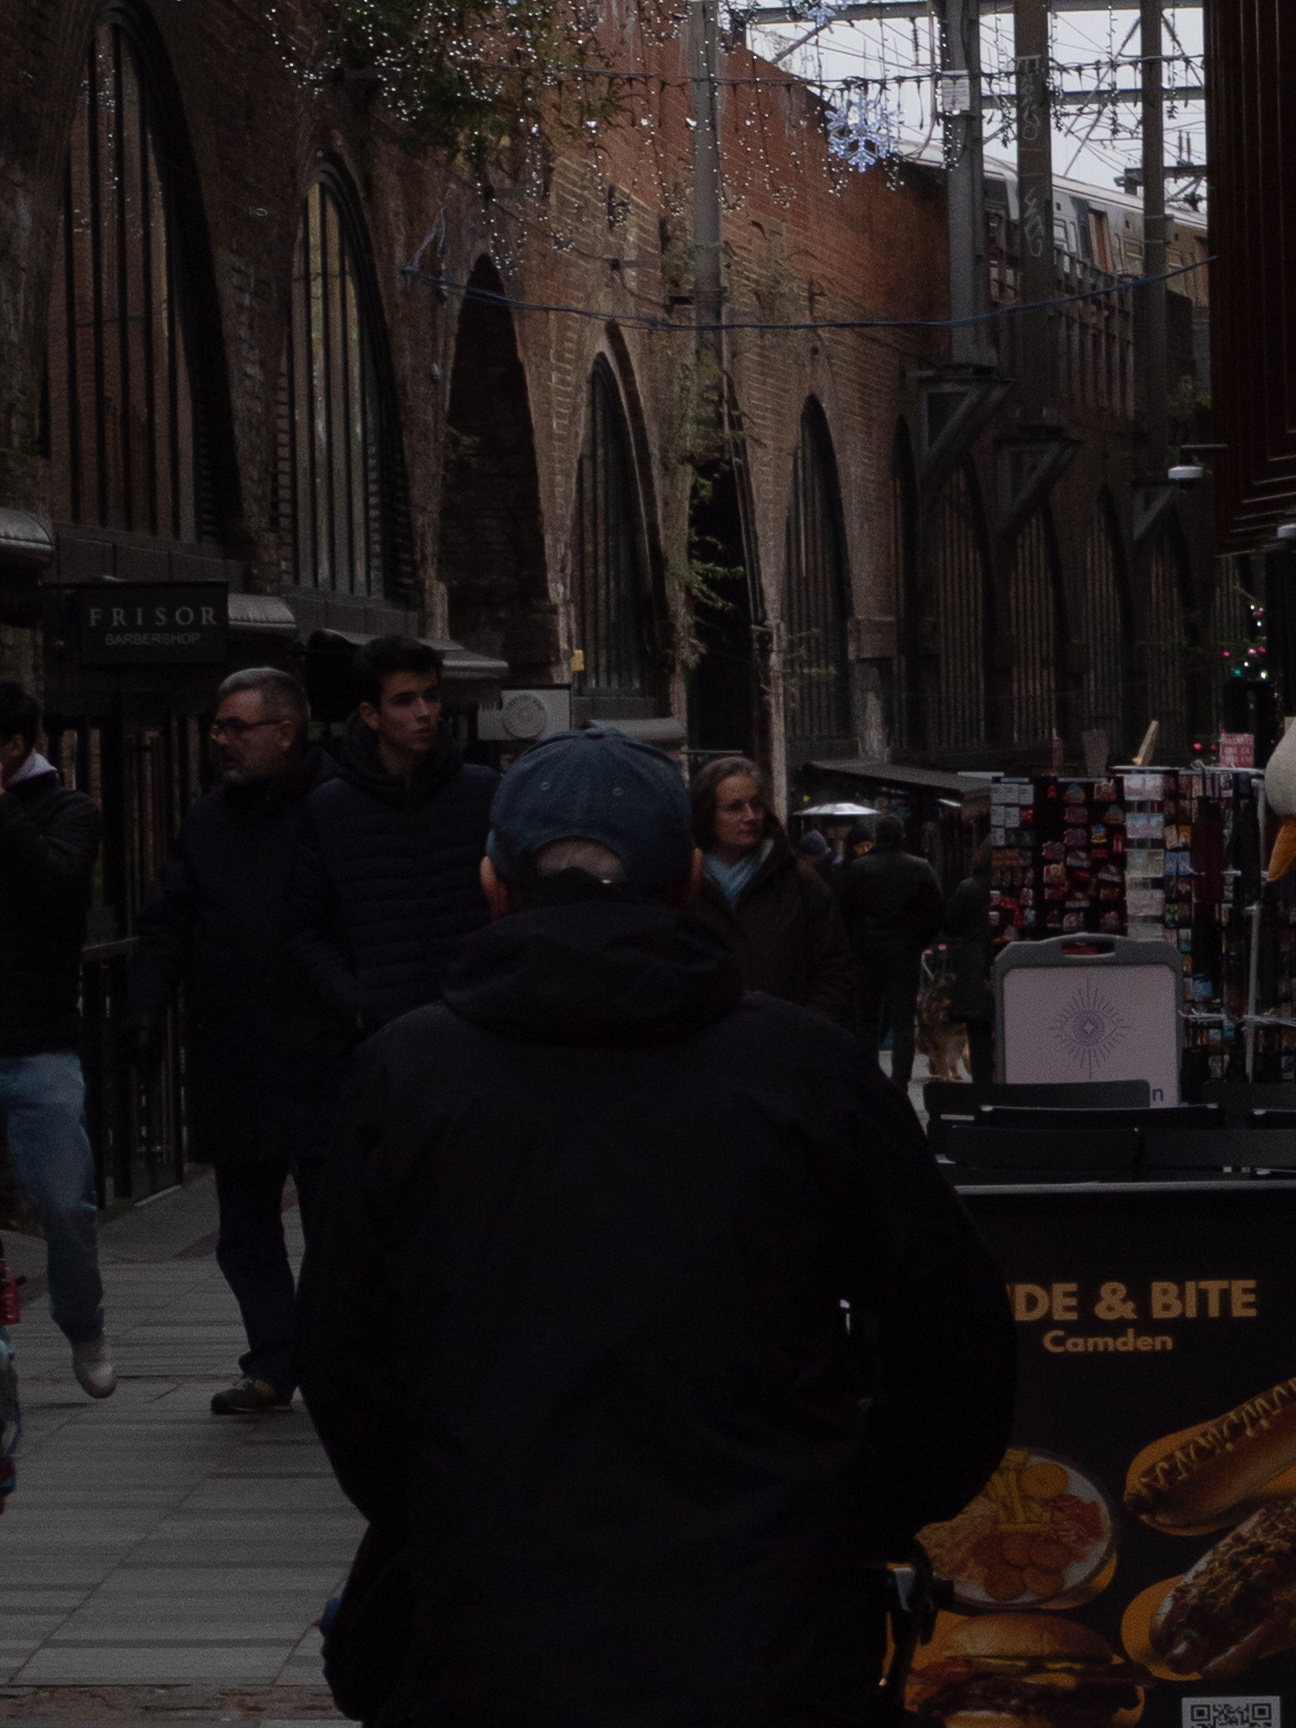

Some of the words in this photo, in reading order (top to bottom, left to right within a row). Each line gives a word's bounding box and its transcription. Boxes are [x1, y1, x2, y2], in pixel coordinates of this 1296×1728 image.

[89, 606, 217, 627] FRISOR
[105, 632, 201, 646] BARBERSHOP
[1006, 1282, 1079, 1321] DE
[1094, 1281, 1138, 1320] &
[1150, 1279, 1258, 1319] BITE
[1043, 1328, 1174, 1353] Camden
